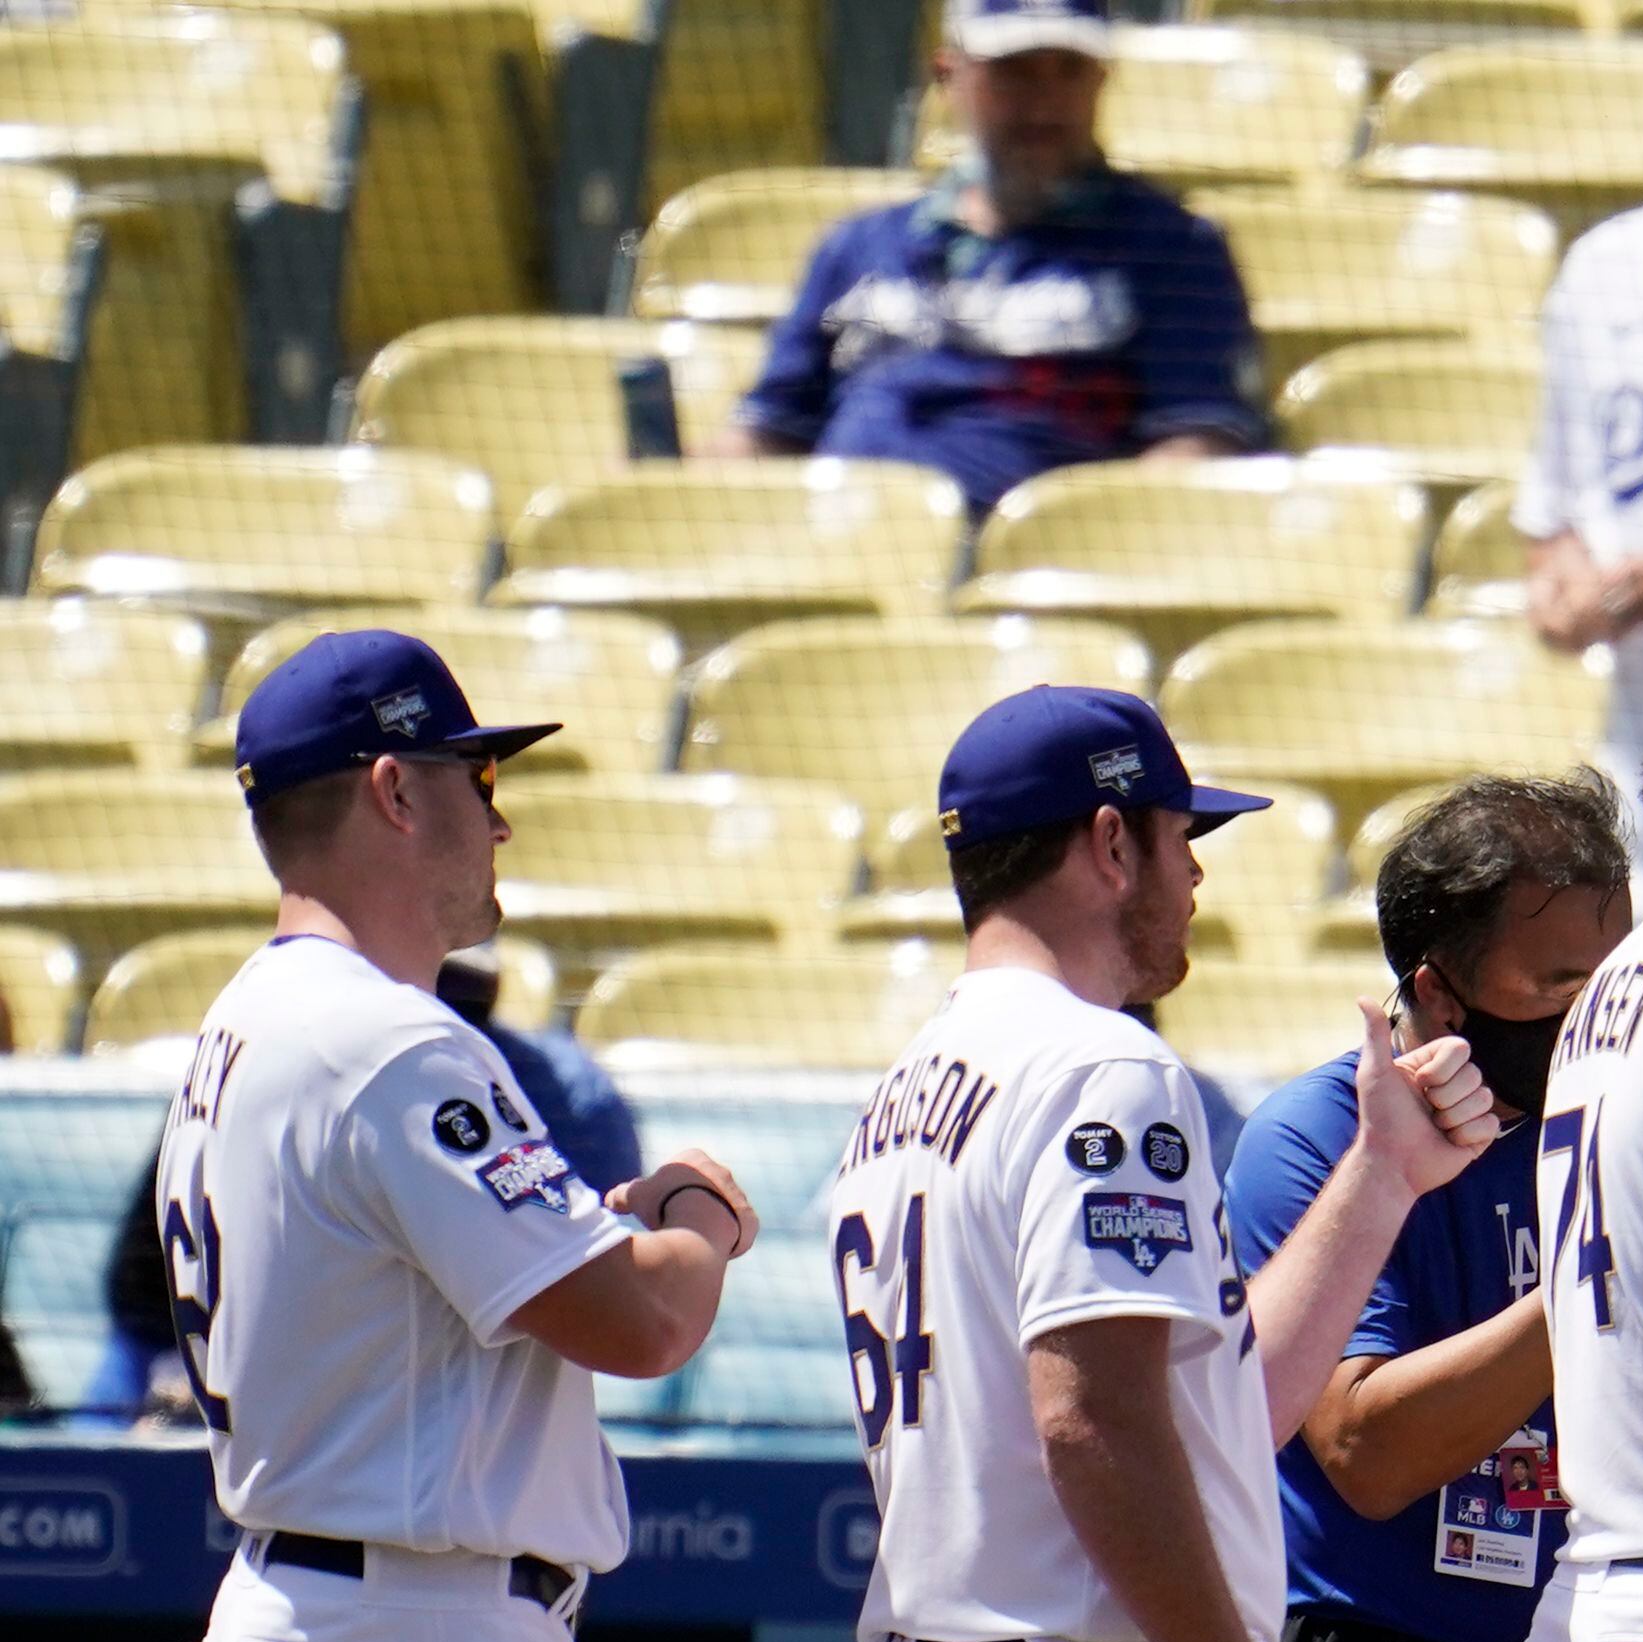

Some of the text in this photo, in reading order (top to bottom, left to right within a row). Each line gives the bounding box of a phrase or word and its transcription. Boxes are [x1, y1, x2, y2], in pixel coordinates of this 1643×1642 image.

[1074, 1129, 1112, 1140] TOMMY
[1085, 1139, 1107, 1166] 2
[1150, 1141, 1183, 1172] 20
[1088, 1205, 1140, 1217] WORLD
[1543, 1093, 1617, 1333] 74
[1090, 1217, 1188, 1242] CHAMPIONS
[835, 1192, 936, 1453] 64
[1457, 1511, 1487, 1526] MLB
